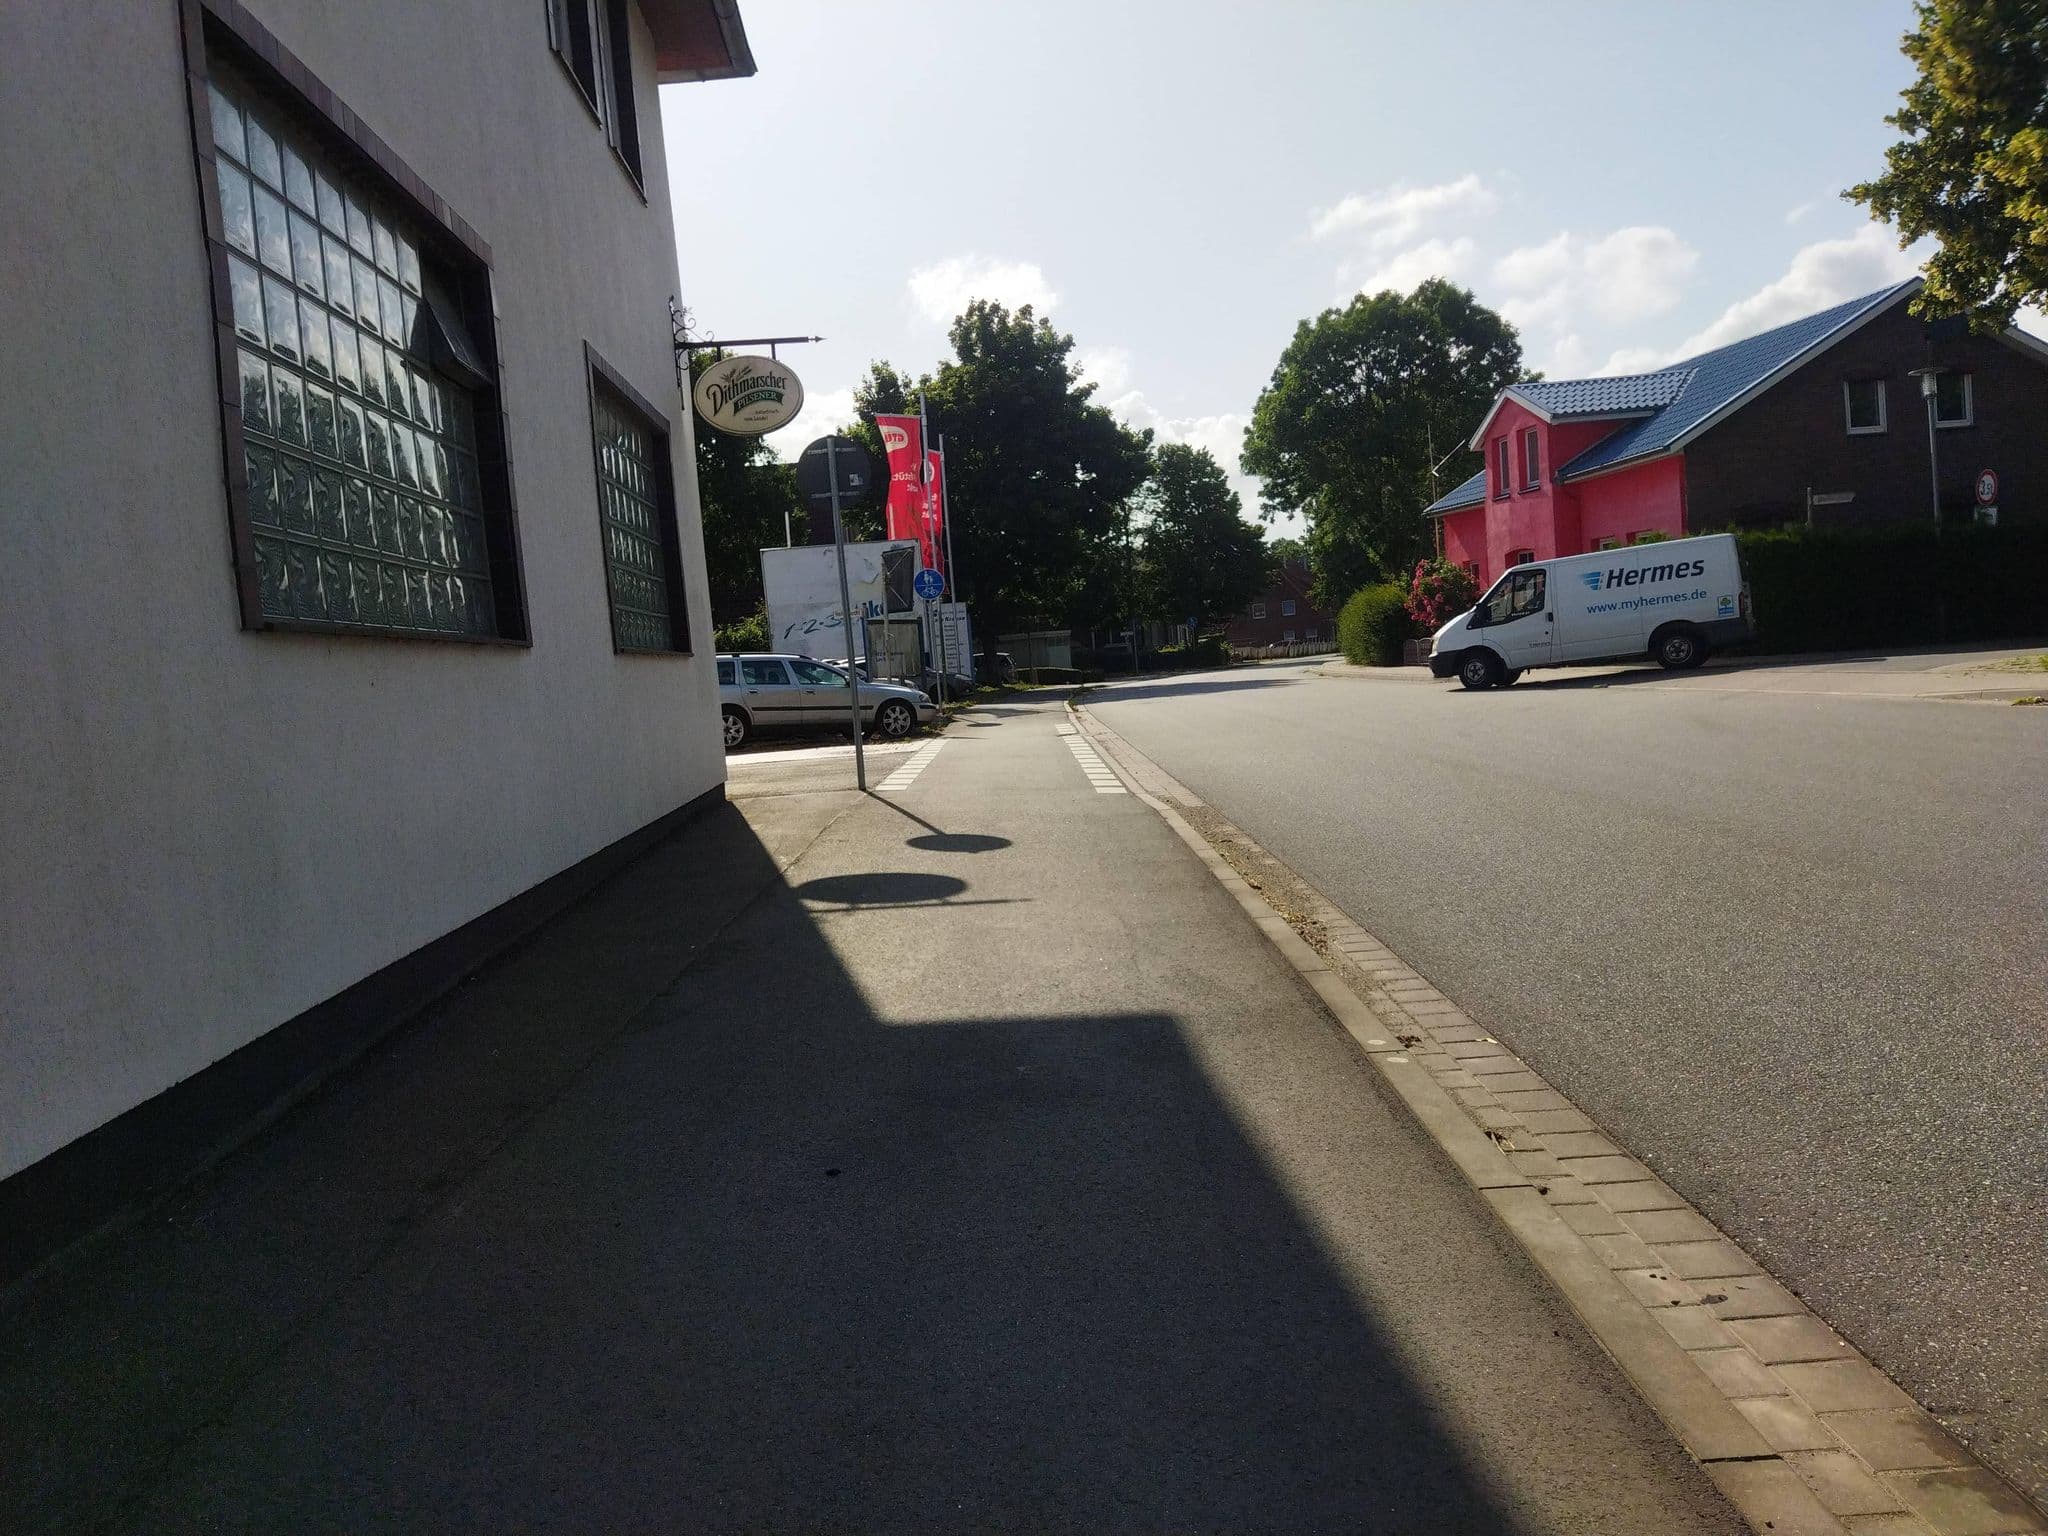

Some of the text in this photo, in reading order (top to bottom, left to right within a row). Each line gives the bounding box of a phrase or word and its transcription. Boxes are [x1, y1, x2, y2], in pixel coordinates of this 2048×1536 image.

[706, 371, 787, 416] Dithmarscher
[738, 391, 777, 409] PILSENER
[1606, 560, 1704, 589] Hermes
[1587, 589, 1707, 614] www.myhermes.de
